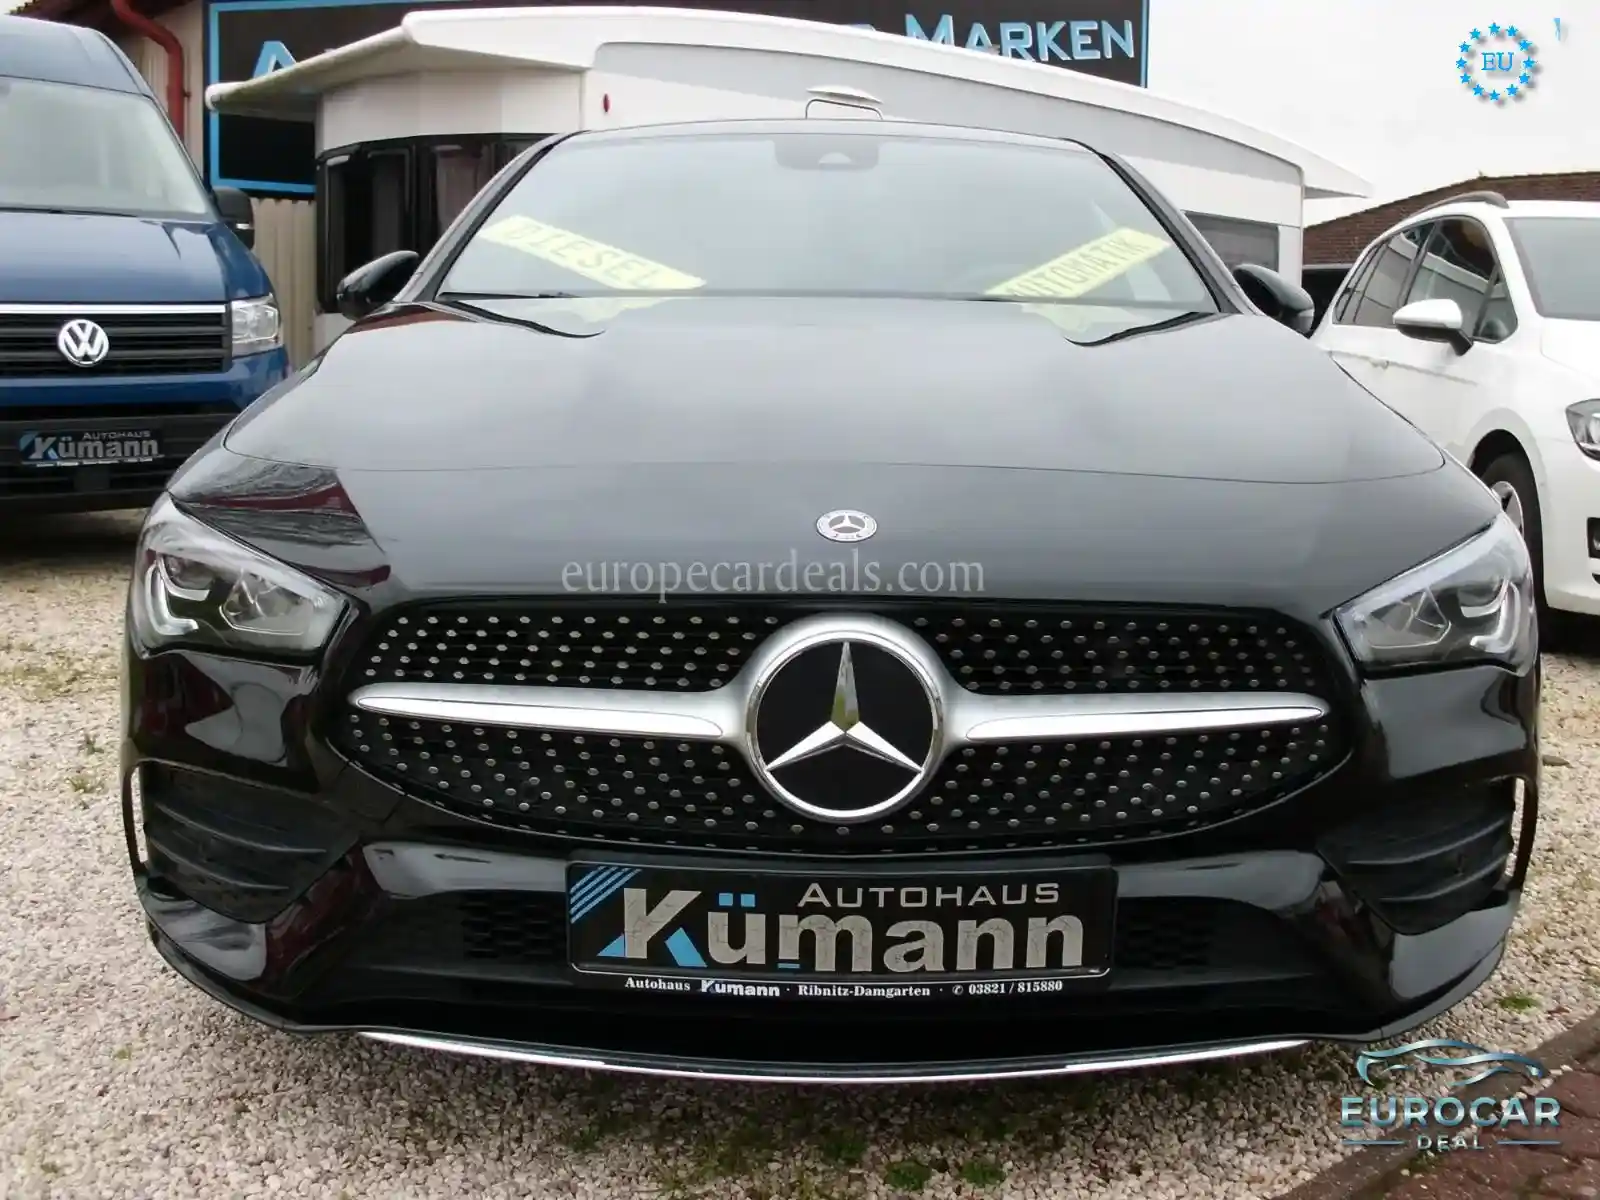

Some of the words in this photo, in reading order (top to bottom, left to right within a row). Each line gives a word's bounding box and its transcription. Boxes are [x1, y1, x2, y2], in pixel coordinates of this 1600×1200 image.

[905, 14, 1135, 62] MARKEN
[82, 430, 151, 441] AUTOHAUS
[28, 436, 159, 460] Kümann
[797, 883, 1060, 908] AUTOHAUS
[597, 887, 1084, 973] Kümann
[624, 977, 690, 991] Autohaus
[797, 983, 931, 999] Ribnitz-Damgarten
